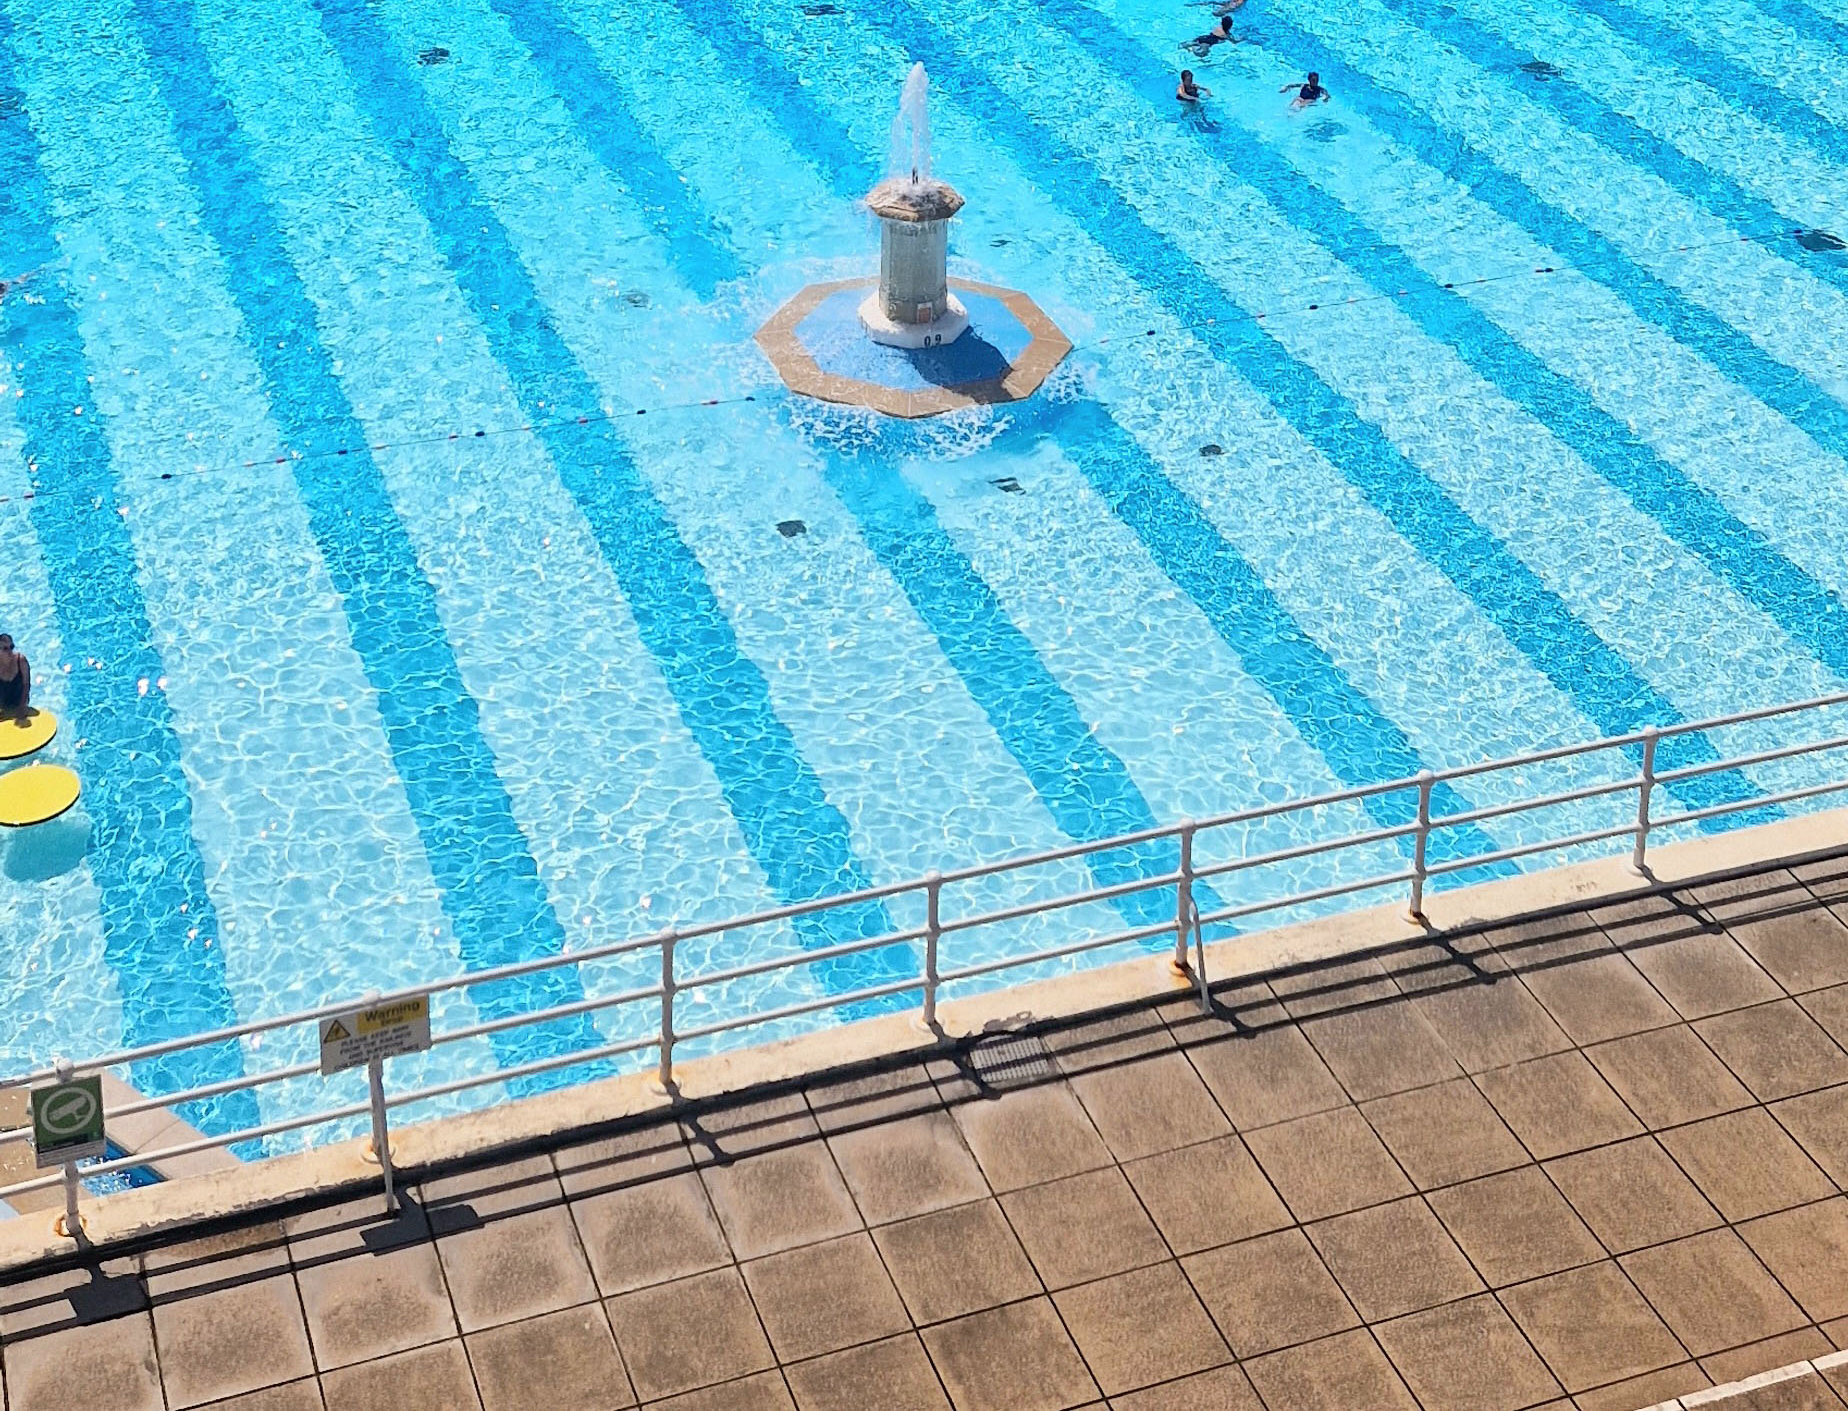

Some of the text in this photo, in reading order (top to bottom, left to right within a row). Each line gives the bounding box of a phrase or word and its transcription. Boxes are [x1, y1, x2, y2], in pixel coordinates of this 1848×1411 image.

[365, 1001, 420, 1022] Warning
[341, 1035, 367, 1047] PLEASE
[340, 1045, 360, 1055] FROM
